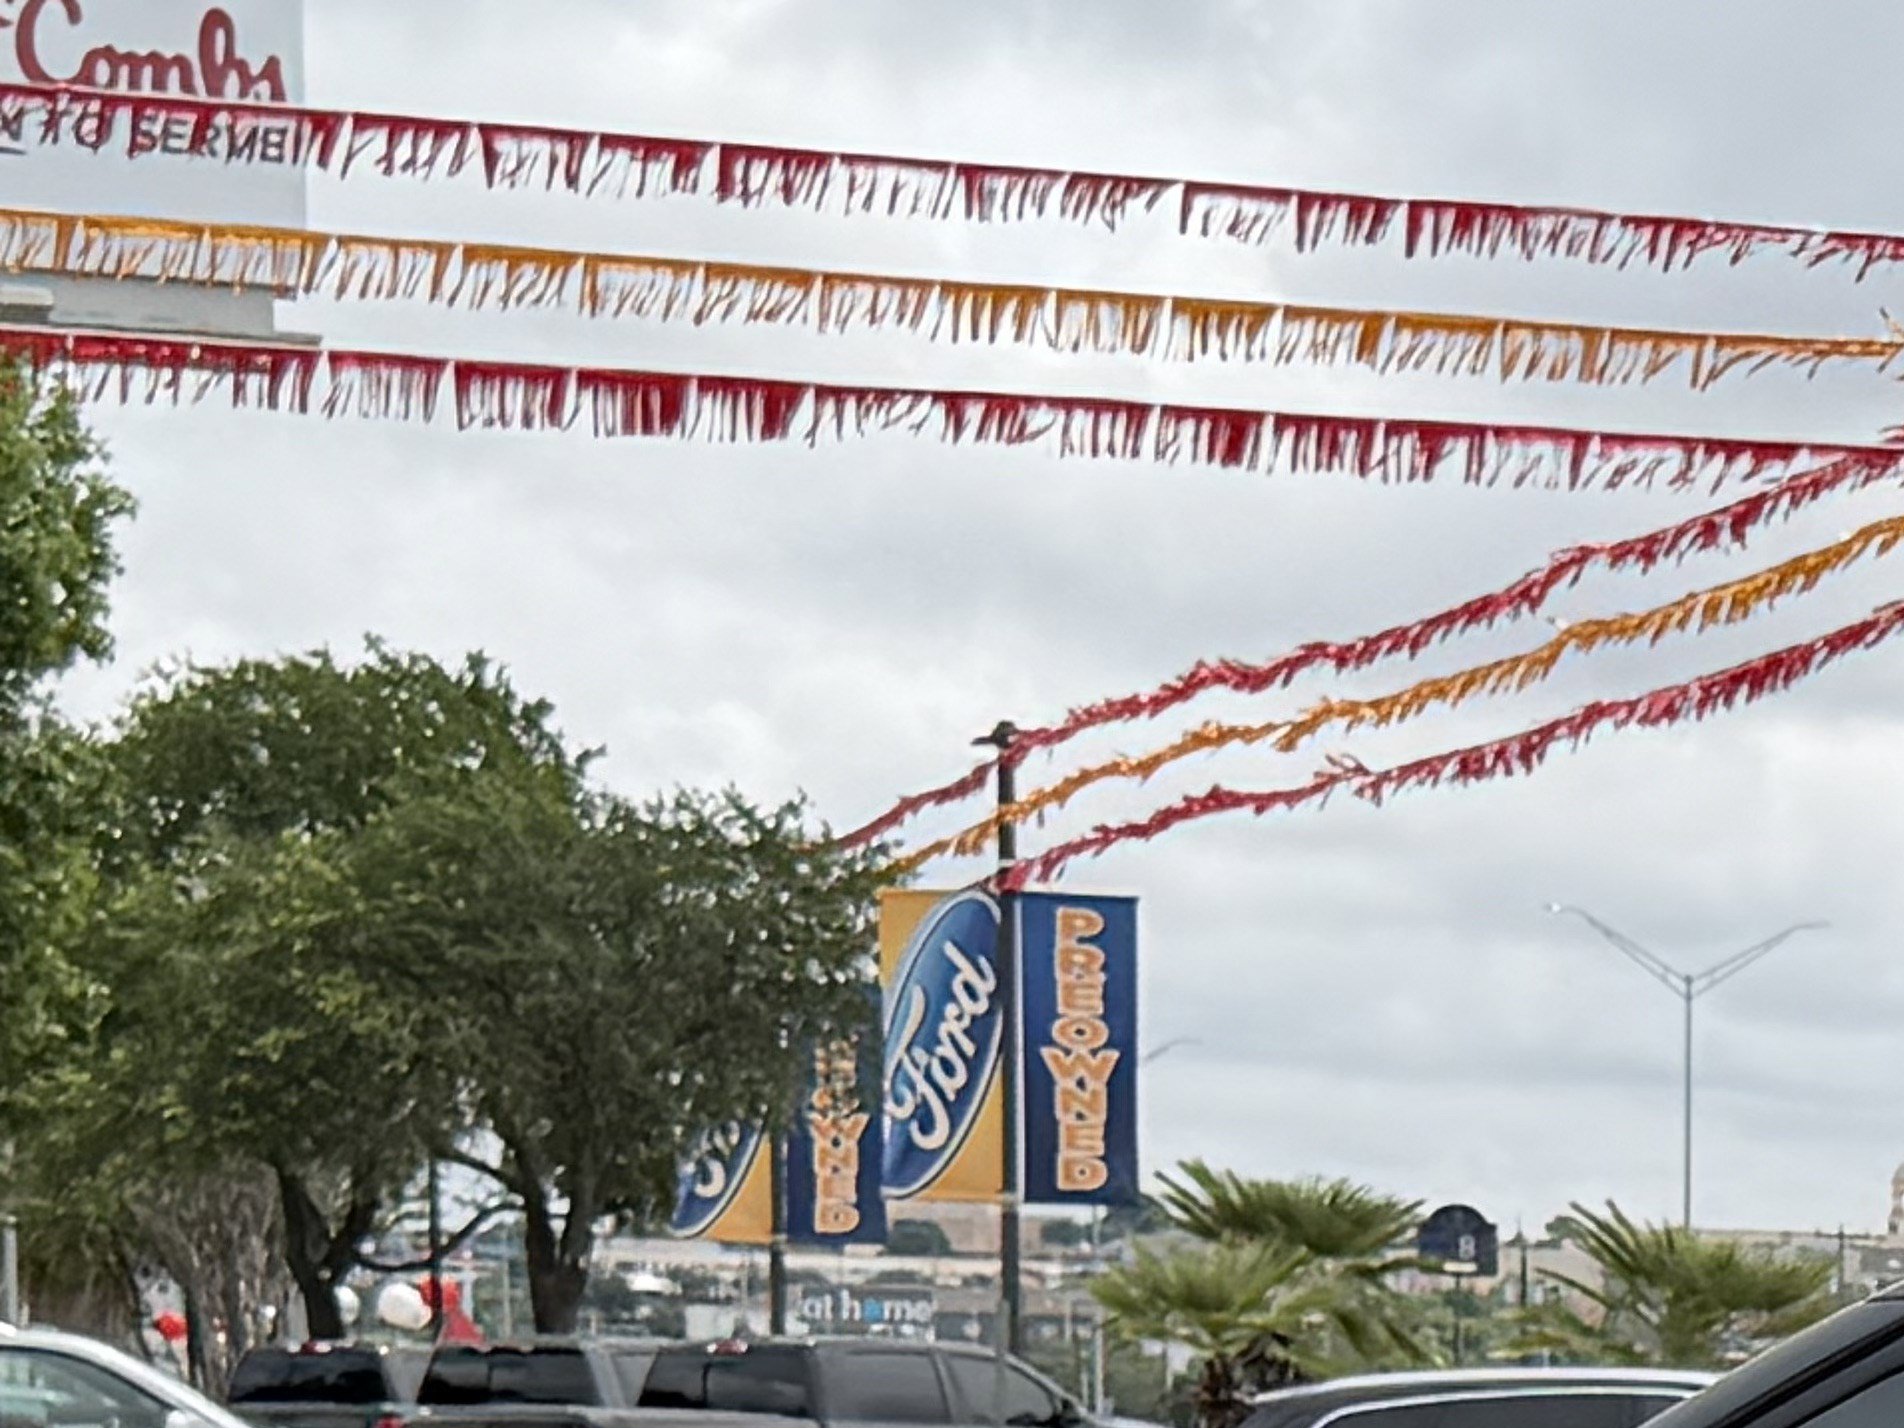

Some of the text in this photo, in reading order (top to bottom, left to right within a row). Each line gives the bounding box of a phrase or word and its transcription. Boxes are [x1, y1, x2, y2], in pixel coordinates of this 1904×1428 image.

[0, 0, 286, 102] Combs
[884, 940, 996, 1150] Ford
[1040, 906, 1121, 1191] PREOWNED
[841, 1288, 933, 1324] home
